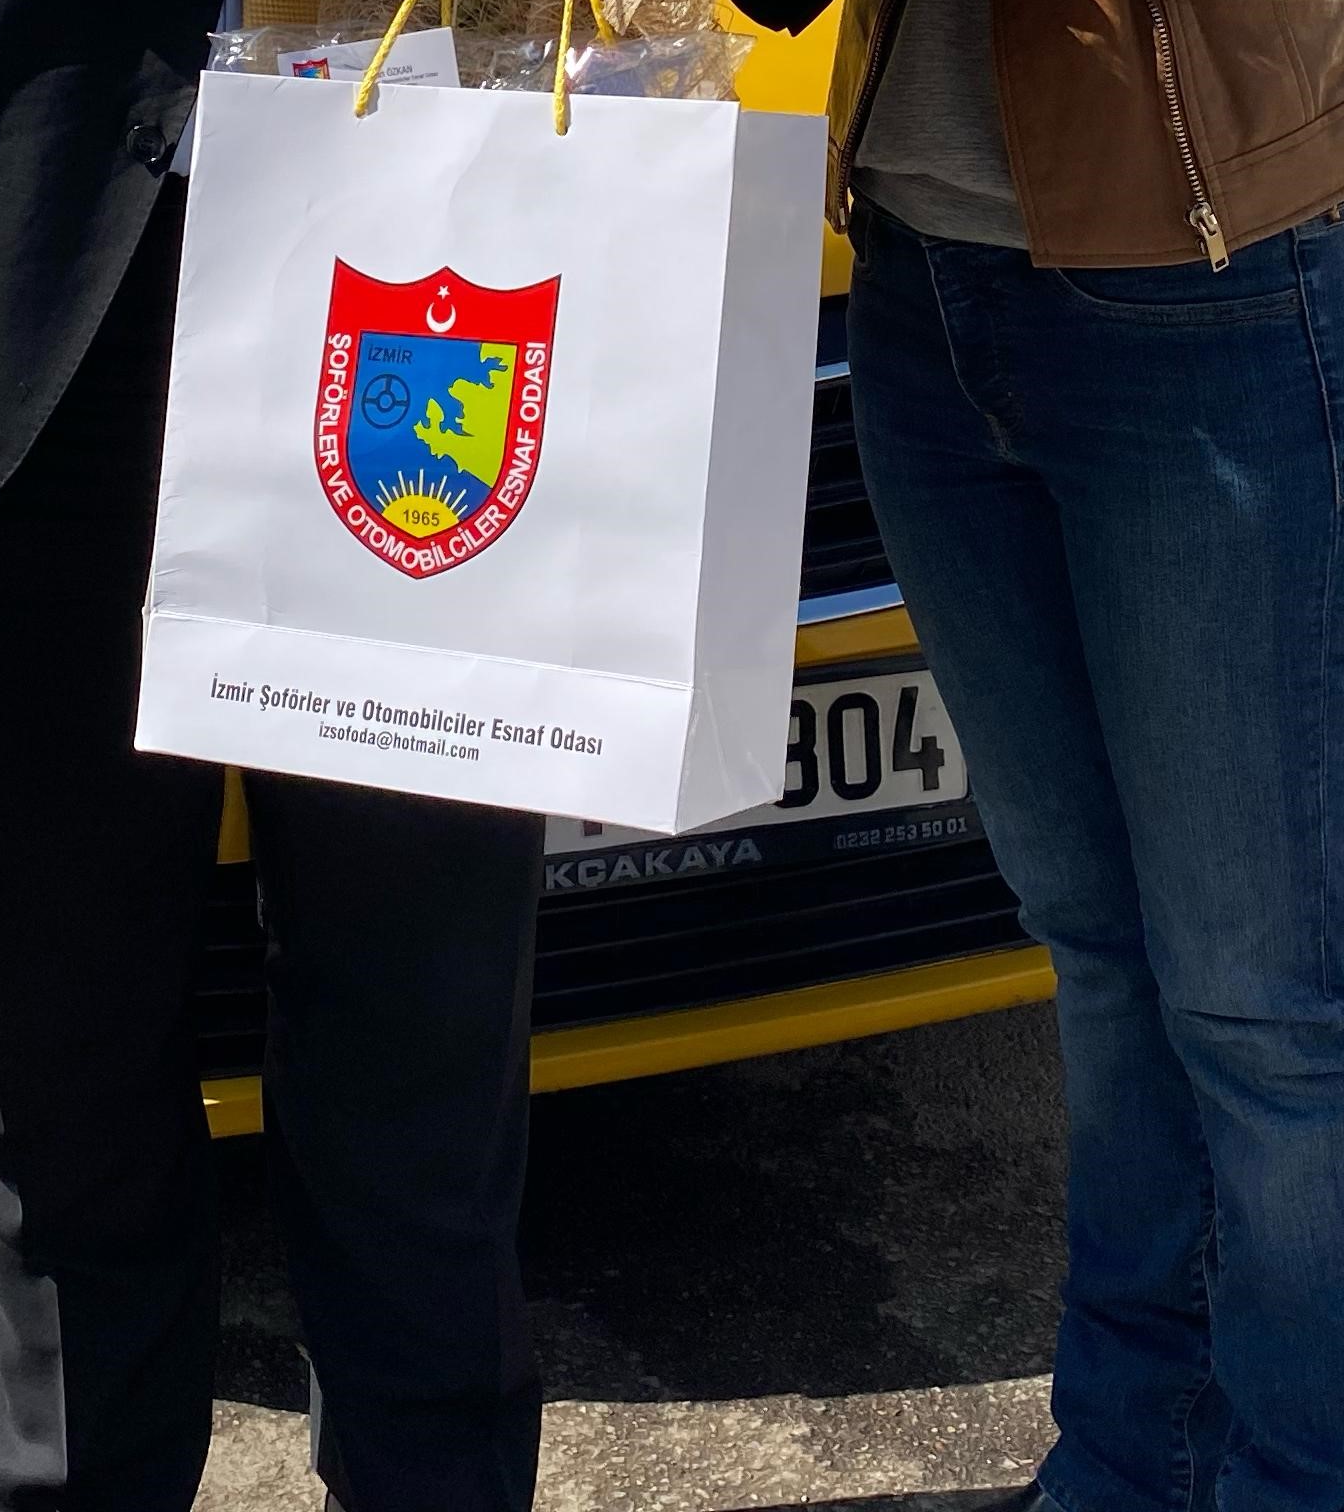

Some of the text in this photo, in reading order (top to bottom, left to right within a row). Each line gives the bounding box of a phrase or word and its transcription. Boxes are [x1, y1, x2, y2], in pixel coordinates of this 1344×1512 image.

[368, 344, 413, 364] İZMİR
[318, 332, 547, 572] ŞOFÖRLER VE OTOMOBİLCİLER ESNAF ODASI
[403, 509, 440, 527] 1965
[210, 672, 603, 756] İzmir Şoförler ve Otomobilciler Esnaf Odası
[318, 720, 480, 761] izsofoda@hotmail.com
[885, 823, 917, 843] 253
[921, 819, 943, 839] 50
[947, 816, 968, 835] 01
